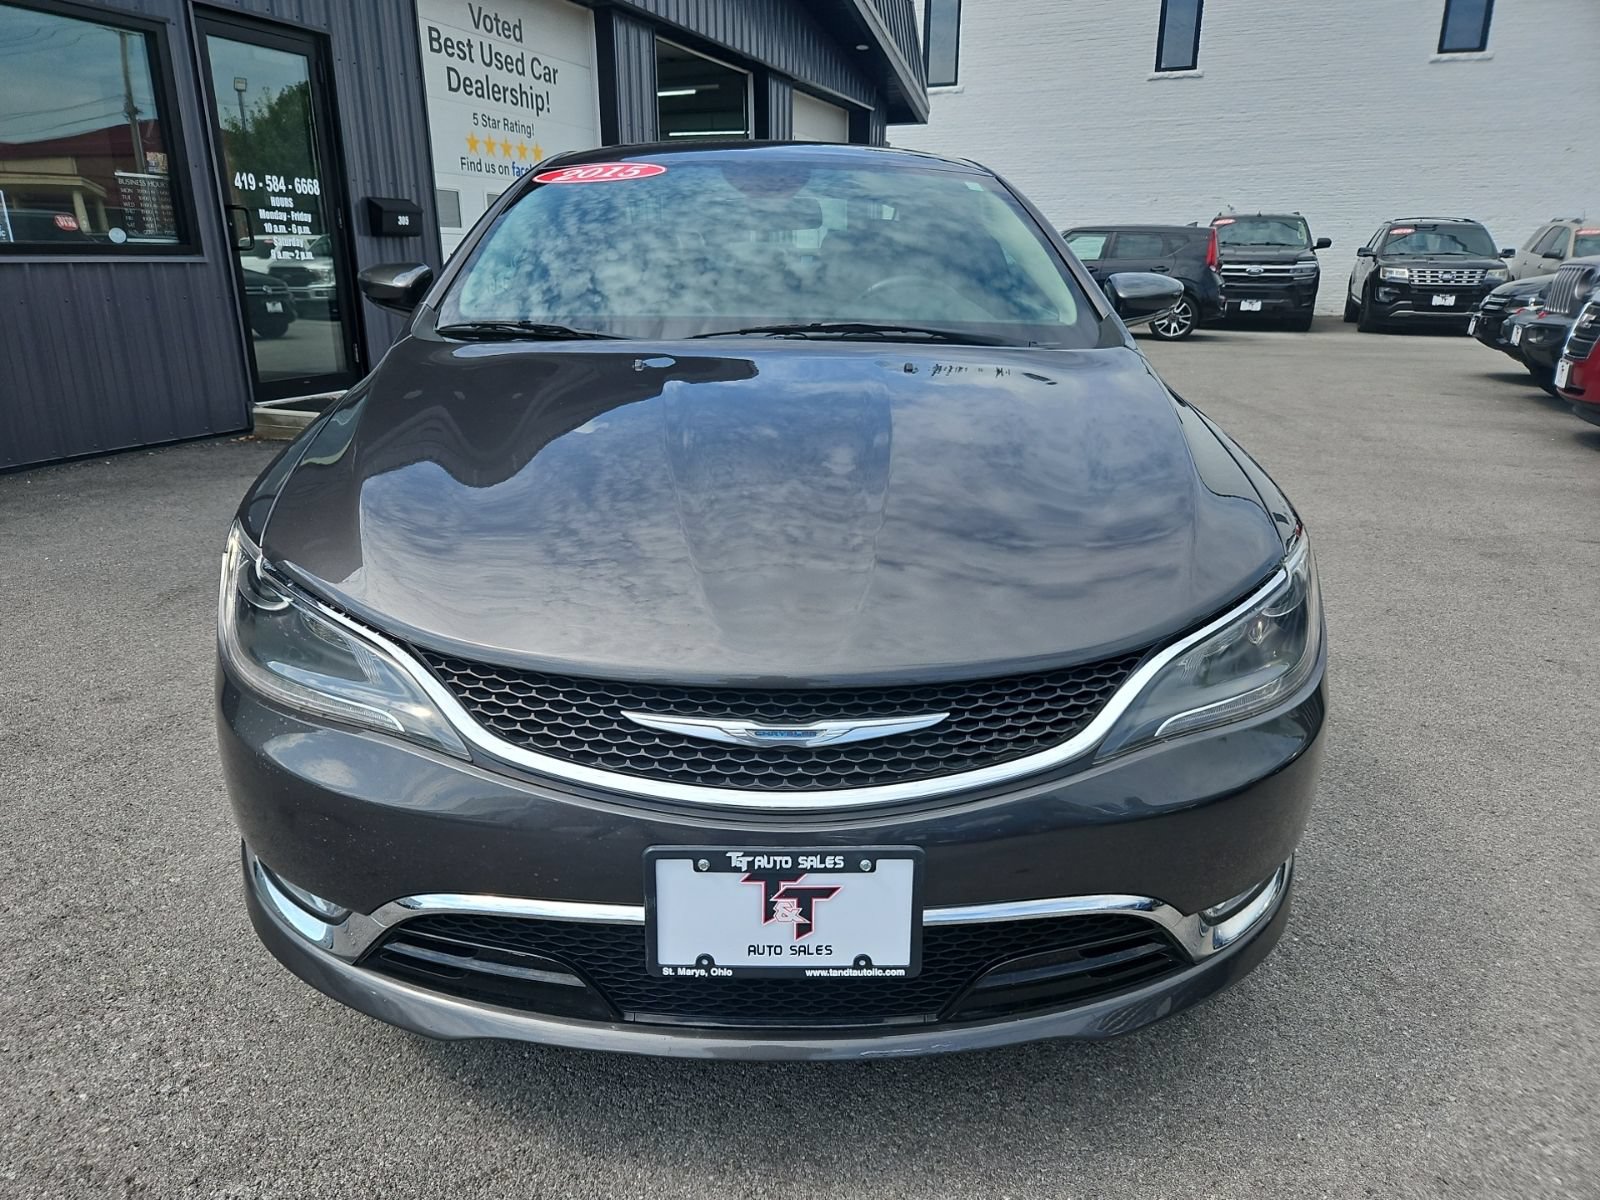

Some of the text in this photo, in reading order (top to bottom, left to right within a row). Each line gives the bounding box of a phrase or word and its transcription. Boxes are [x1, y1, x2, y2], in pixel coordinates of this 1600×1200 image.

[468, 2, 523, 43] Voted
[428, 26, 558, 85] Best Used Car
[446, 66, 550, 117] Dealership!
[472, 113, 534, 138] 5 Star Rating!
[460, 157, 482, 173] Find
[485, 163, 496, 174] us
[498, 164, 510, 176] on
[552, 165, 649, 181] 2015
[118, 178, 146, 186] BUSINESS
[235, 172, 256, 190] 419
[265, 174, 286, 192] 584
[294, 177, 320, 196] 6668
[270, 196, 294, 208] HOURS
[258, 208, 287, 221] Monday
[291, 210, 312, 223] Friday
[264, 222, 272, 233] 10
[291, 224, 297, 234] 6
[273, 236, 304, 248] Saturday
[294, 250, 300, 260] 2
[755, 854, 792, 870] AUTO
[798, 854, 844, 870] SALES
[748, 944, 833, 957] AUTO SALES
[662, 967, 733, 978] St. Marys, Ohio
